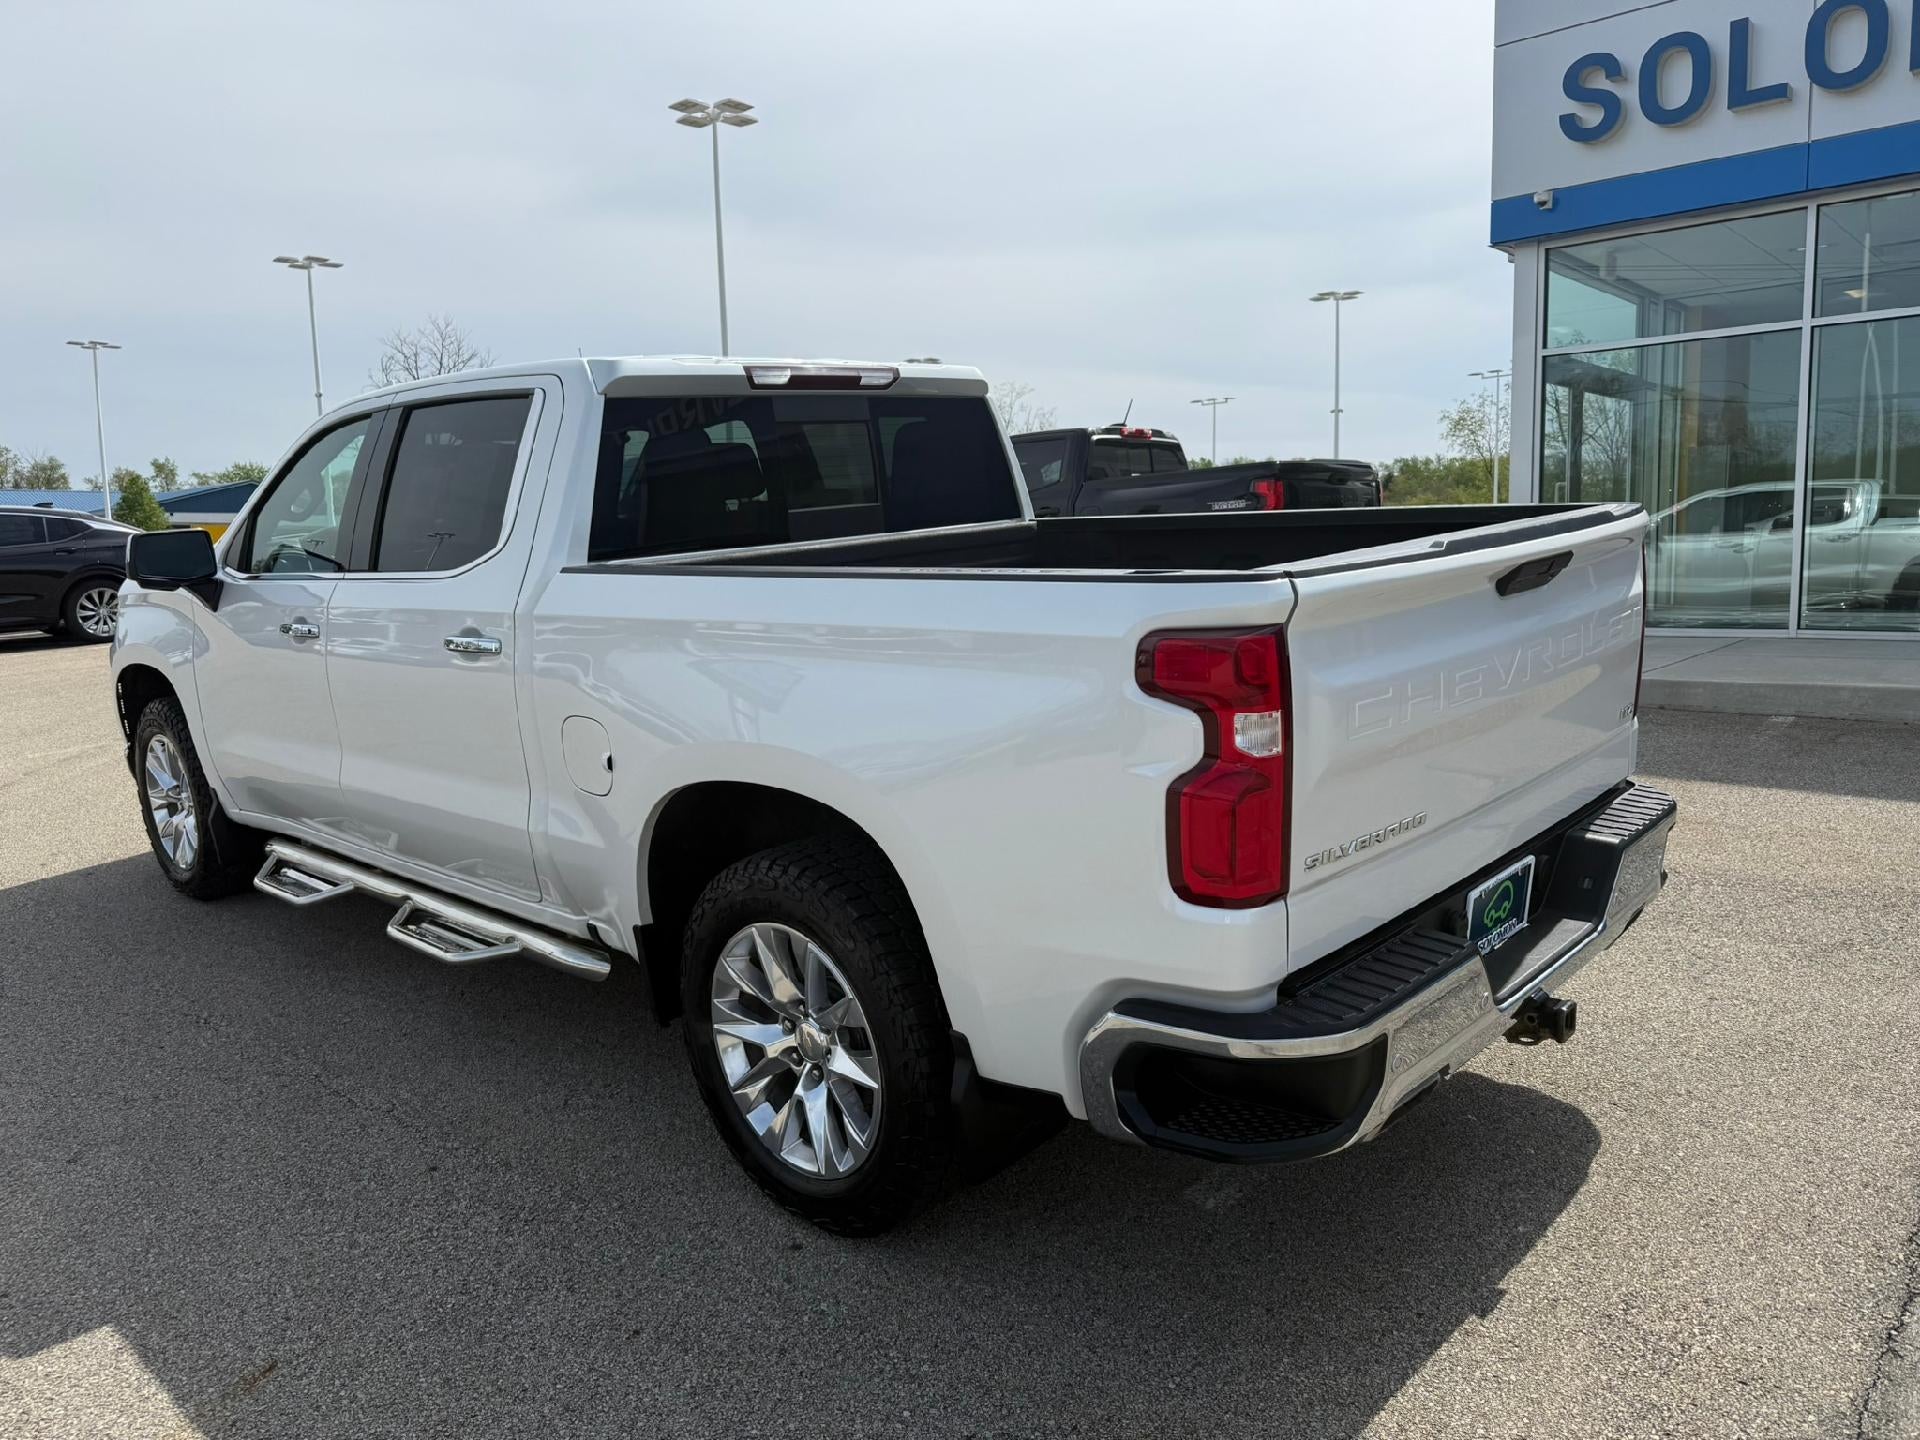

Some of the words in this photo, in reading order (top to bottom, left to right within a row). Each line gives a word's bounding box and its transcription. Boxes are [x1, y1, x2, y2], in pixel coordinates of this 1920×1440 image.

[1559, 0, 1920, 143] SOLO
[1346, 605, 1642, 741] CHEVROLET
[1304, 811, 1427, 872] SILVERADO
